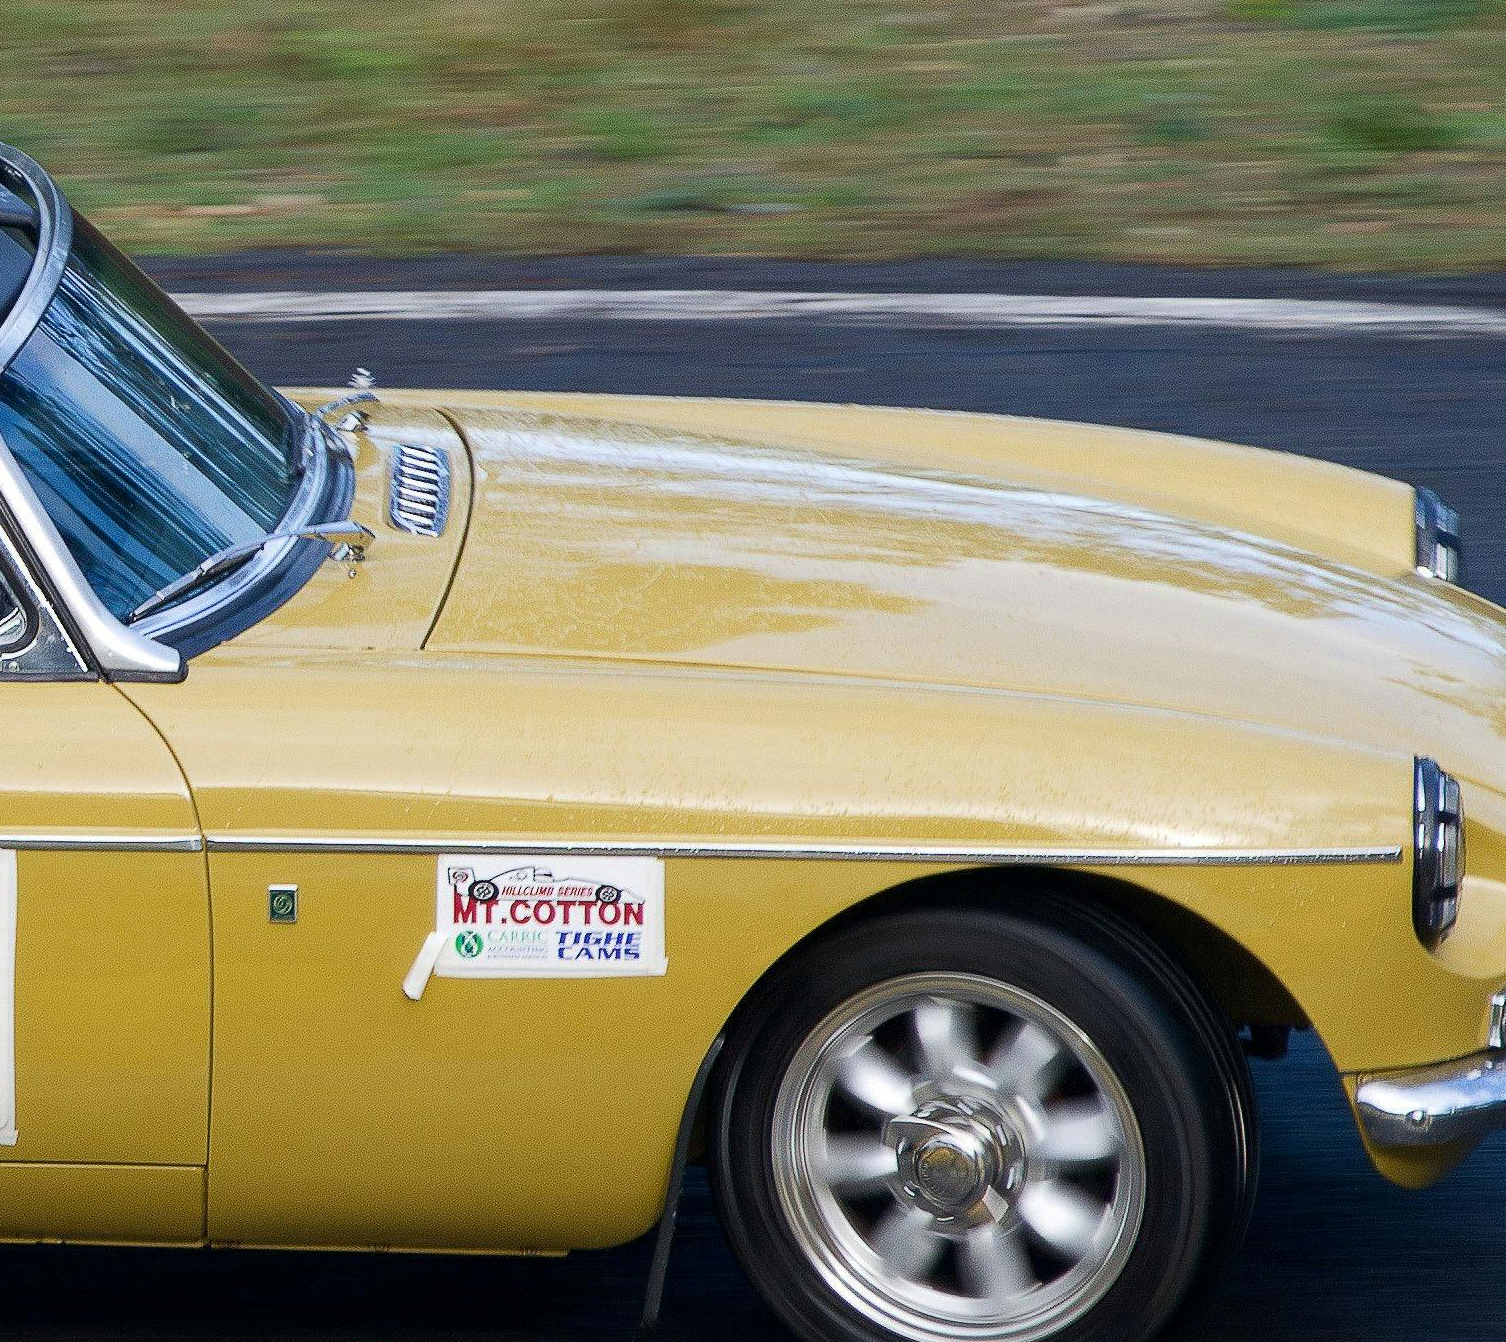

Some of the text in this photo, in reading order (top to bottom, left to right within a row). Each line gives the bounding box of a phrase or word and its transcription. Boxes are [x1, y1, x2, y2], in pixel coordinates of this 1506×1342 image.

[501, 885, 593, 897] HILLCLIMB SERIES
[556, 930, 642, 946] TIGHE
[557, 947, 641, 960] CAMS
